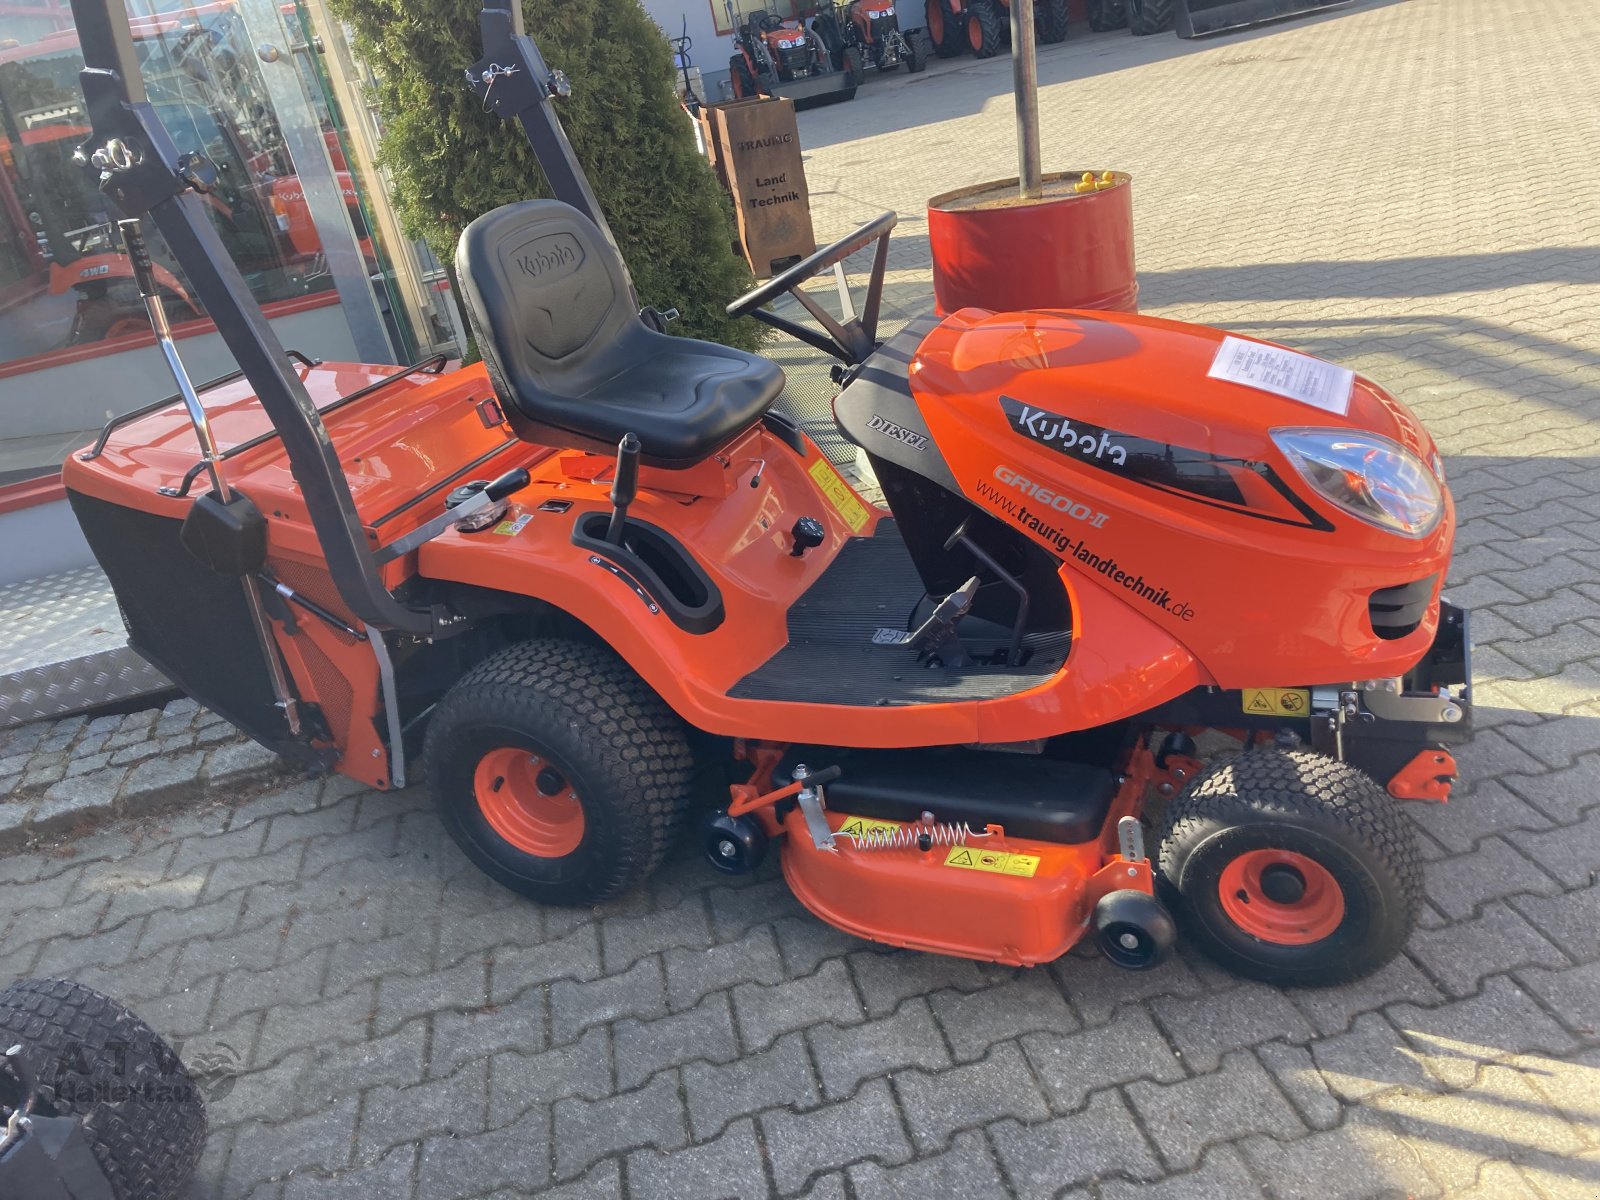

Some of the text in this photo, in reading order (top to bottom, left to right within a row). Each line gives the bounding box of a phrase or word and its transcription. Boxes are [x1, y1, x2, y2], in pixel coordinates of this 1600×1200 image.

[755, 173, 786, 187] Land
[749, 191, 800, 208] Technik
[79, 264, 109, 277] 4WD
[516, 243, 575, 277] Kubota
[865, 414, 929, 451] DIESEL
[1018, 406, 1127, 466] Kubota
[975, 478, 1195, 622] www.traurig-landtechnik.de
